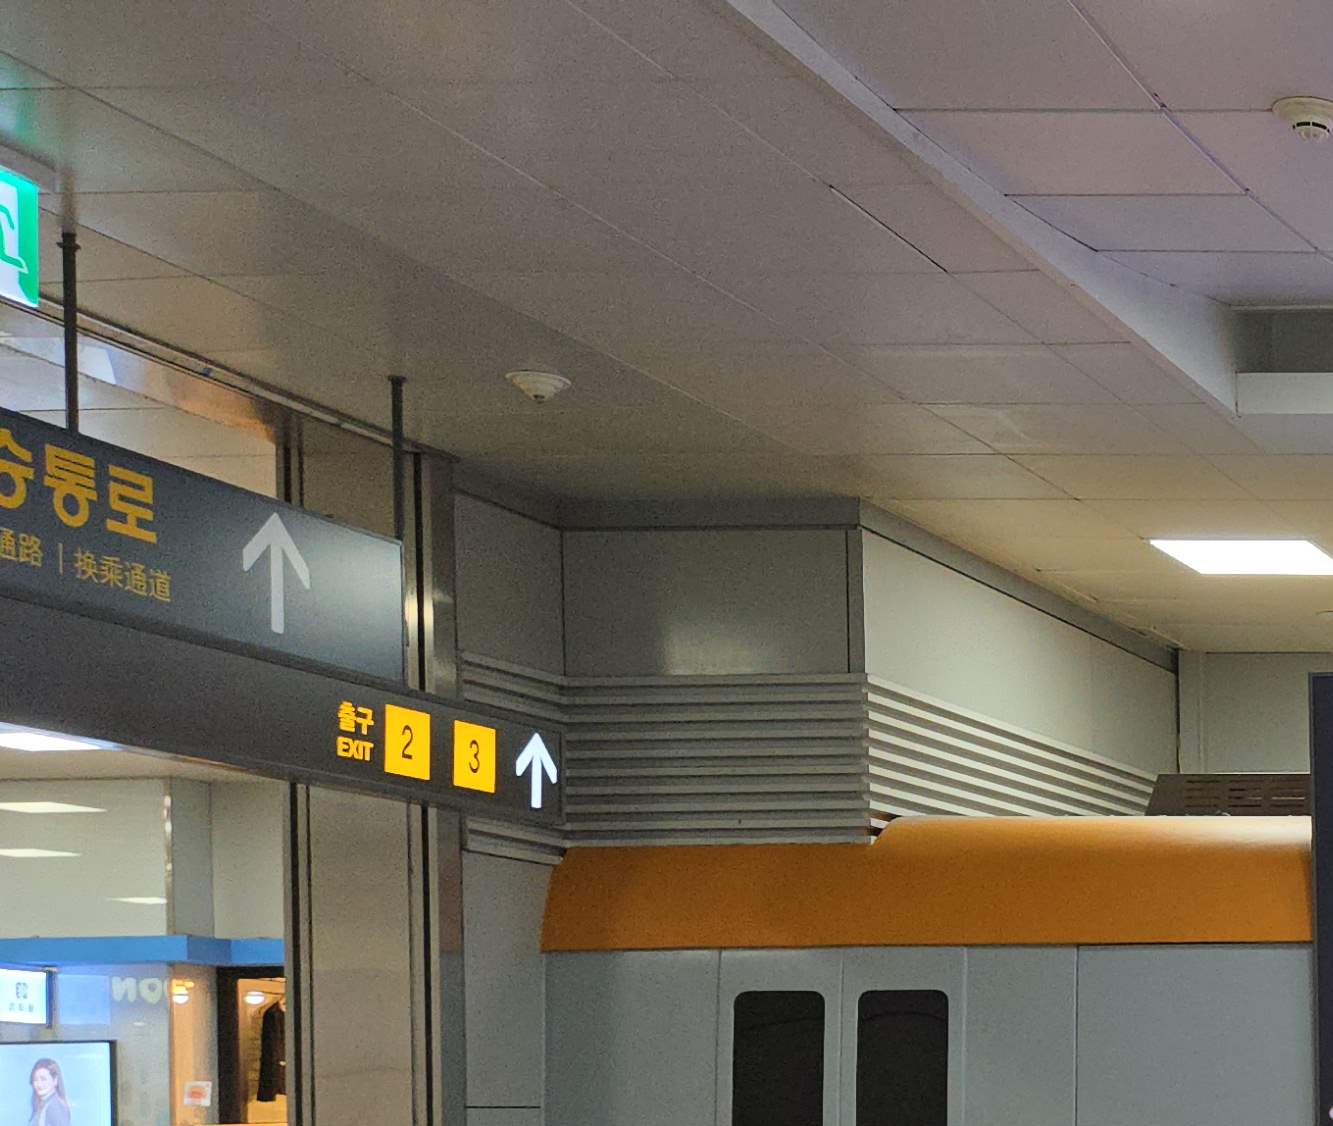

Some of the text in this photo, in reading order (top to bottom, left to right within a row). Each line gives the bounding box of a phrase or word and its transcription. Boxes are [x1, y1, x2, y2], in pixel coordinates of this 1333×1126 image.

[74, 549, 171, 602] 换乘通道
[337, 701, 374, 735] 출구
[336, 736, 374, 762] EXIT
[401, 724, 480, 773] 2 3
